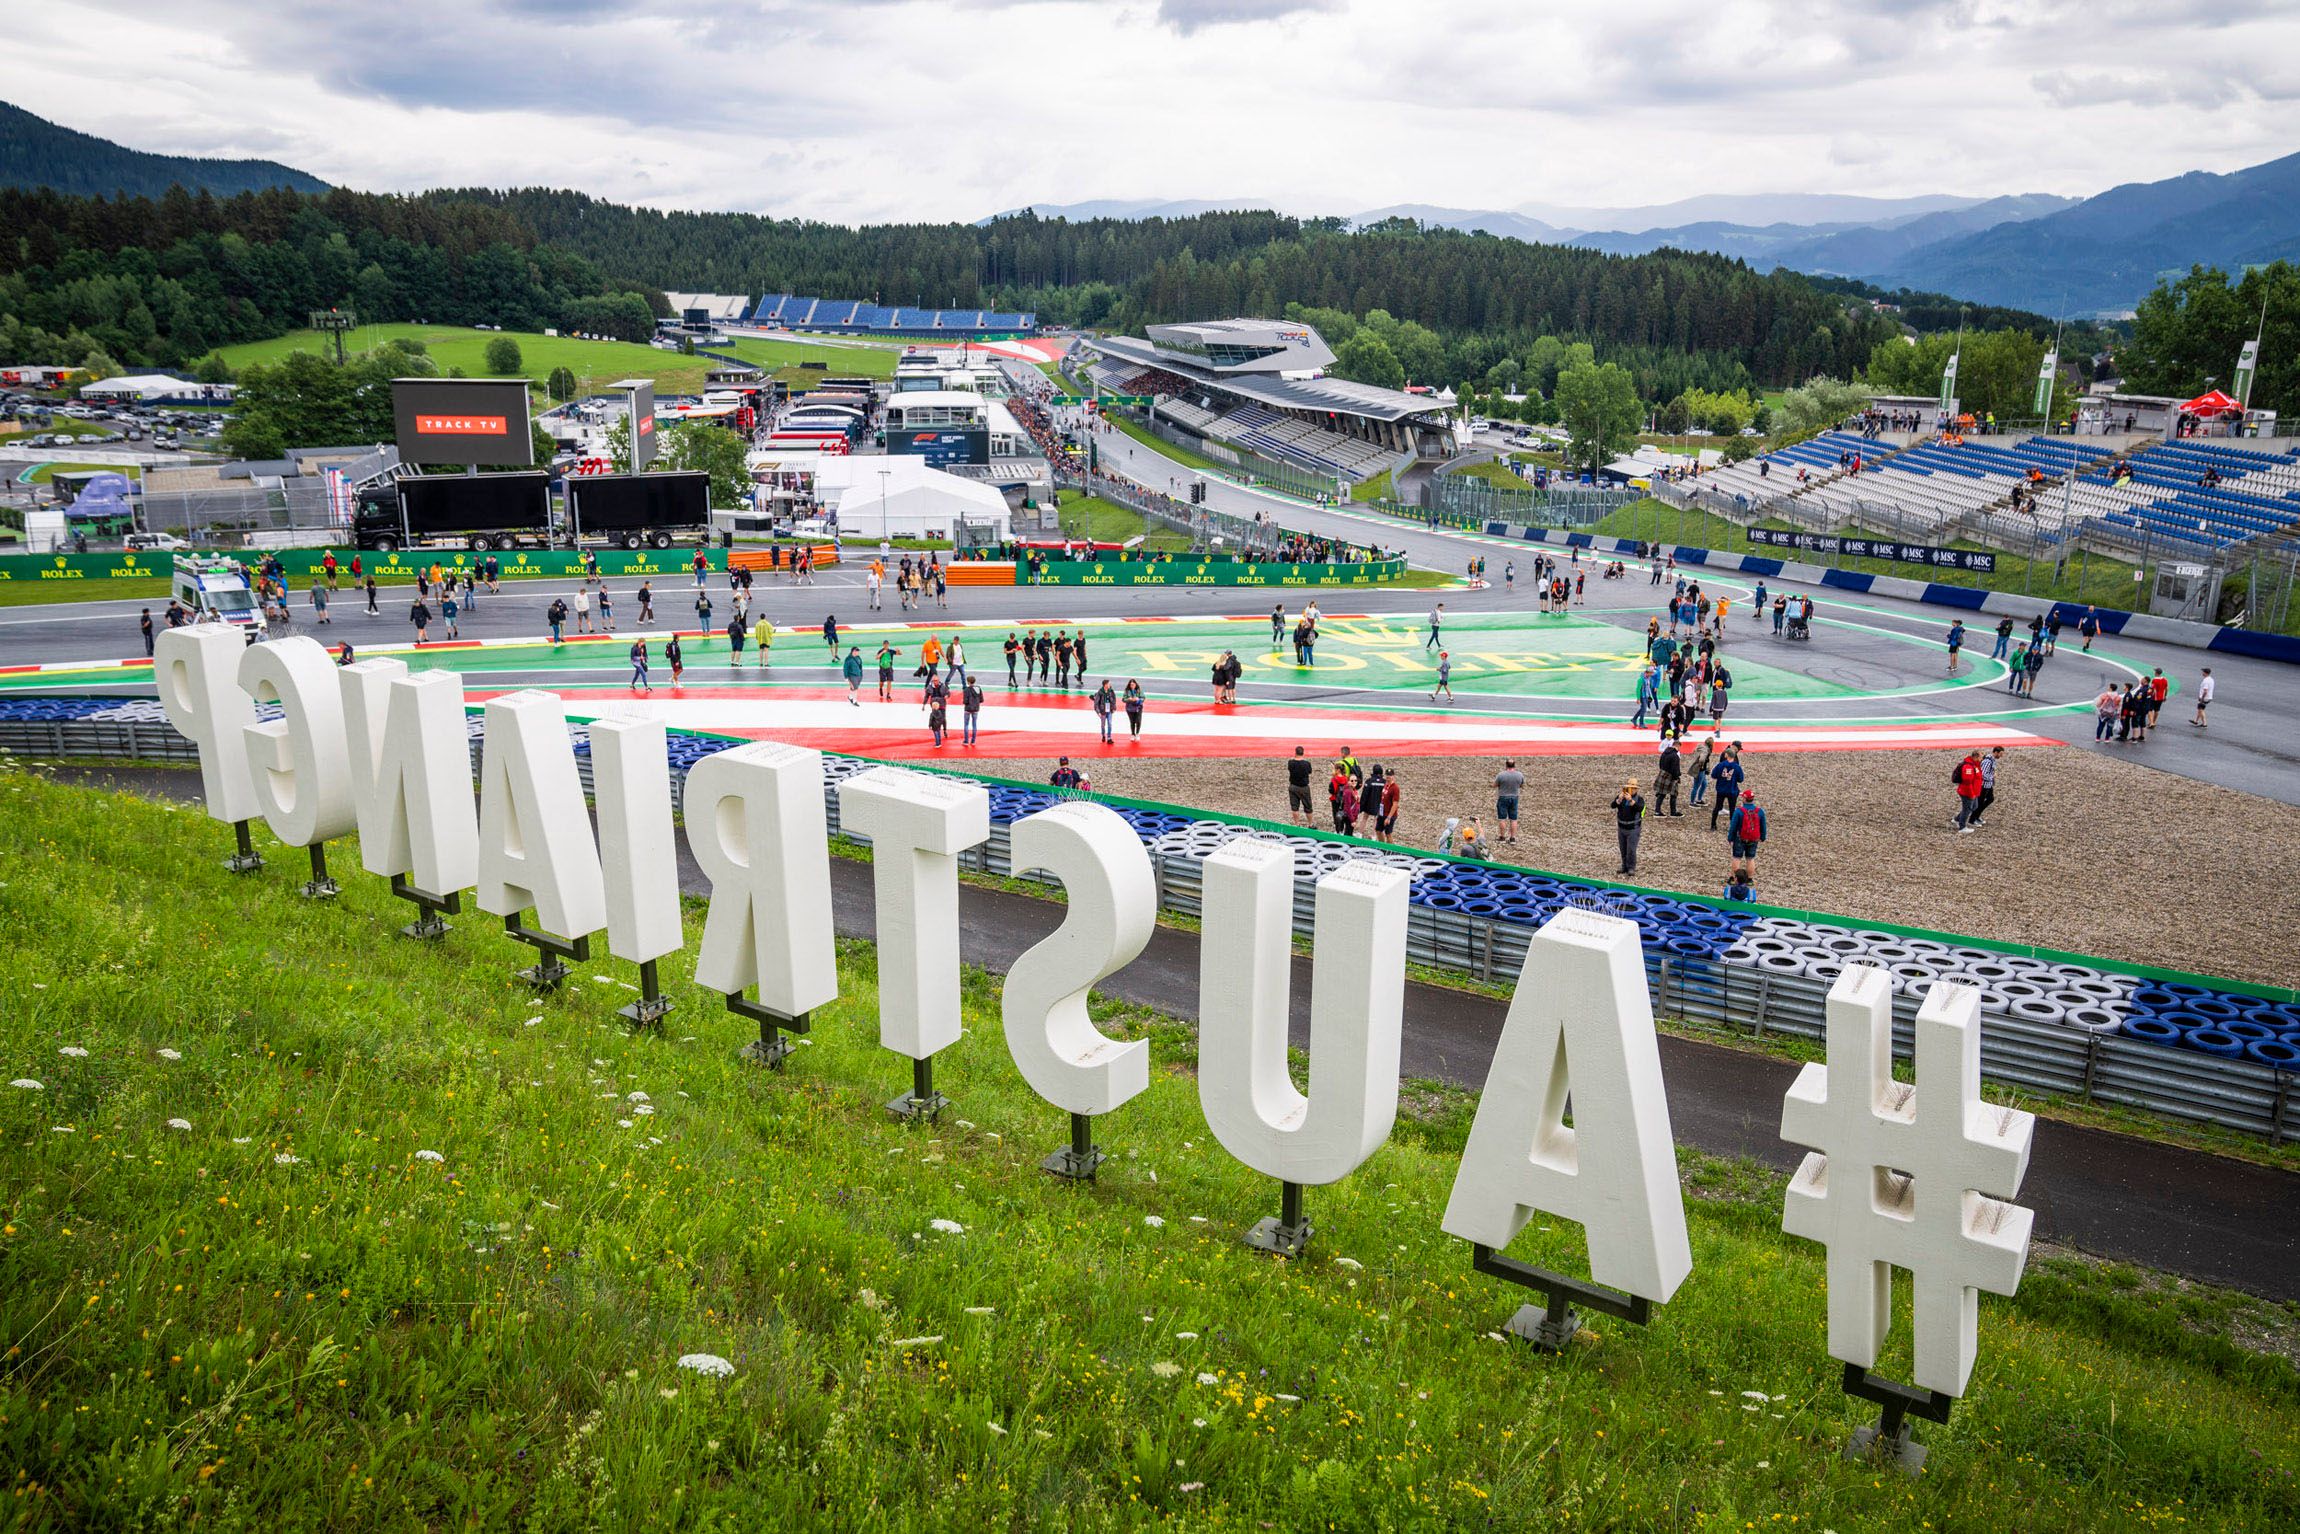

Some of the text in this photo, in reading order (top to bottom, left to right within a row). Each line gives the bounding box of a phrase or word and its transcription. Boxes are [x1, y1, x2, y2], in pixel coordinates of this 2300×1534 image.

[425, 420, 496, 429] TRACK TV
[1755, 531, 1767, 539] MSC
[1777, 533, 1789, 542] MSC
[1852, 542, 1865, 551] MSC
[1880, 545, 1894, 555] MSC
[1908, 548, 1924, 558] MSC
[1940, 551, 1957, 562] MSC
[1973, 555, 1992, 567] MSC
[111, 568, 152, 577] ROLEX
[375, 566, 414, 575] ROLEX
[504, 565, 541, 574] ROLEX
[624, 564, 659, 573] ROLEX
[41, 569, 84, 579] ROLEX
[1185, 576, 1215, 584] ROLEX
[1237, 576, 1265, 584] ROLEX
[1125, 650, 1652, 672] ROLEX
